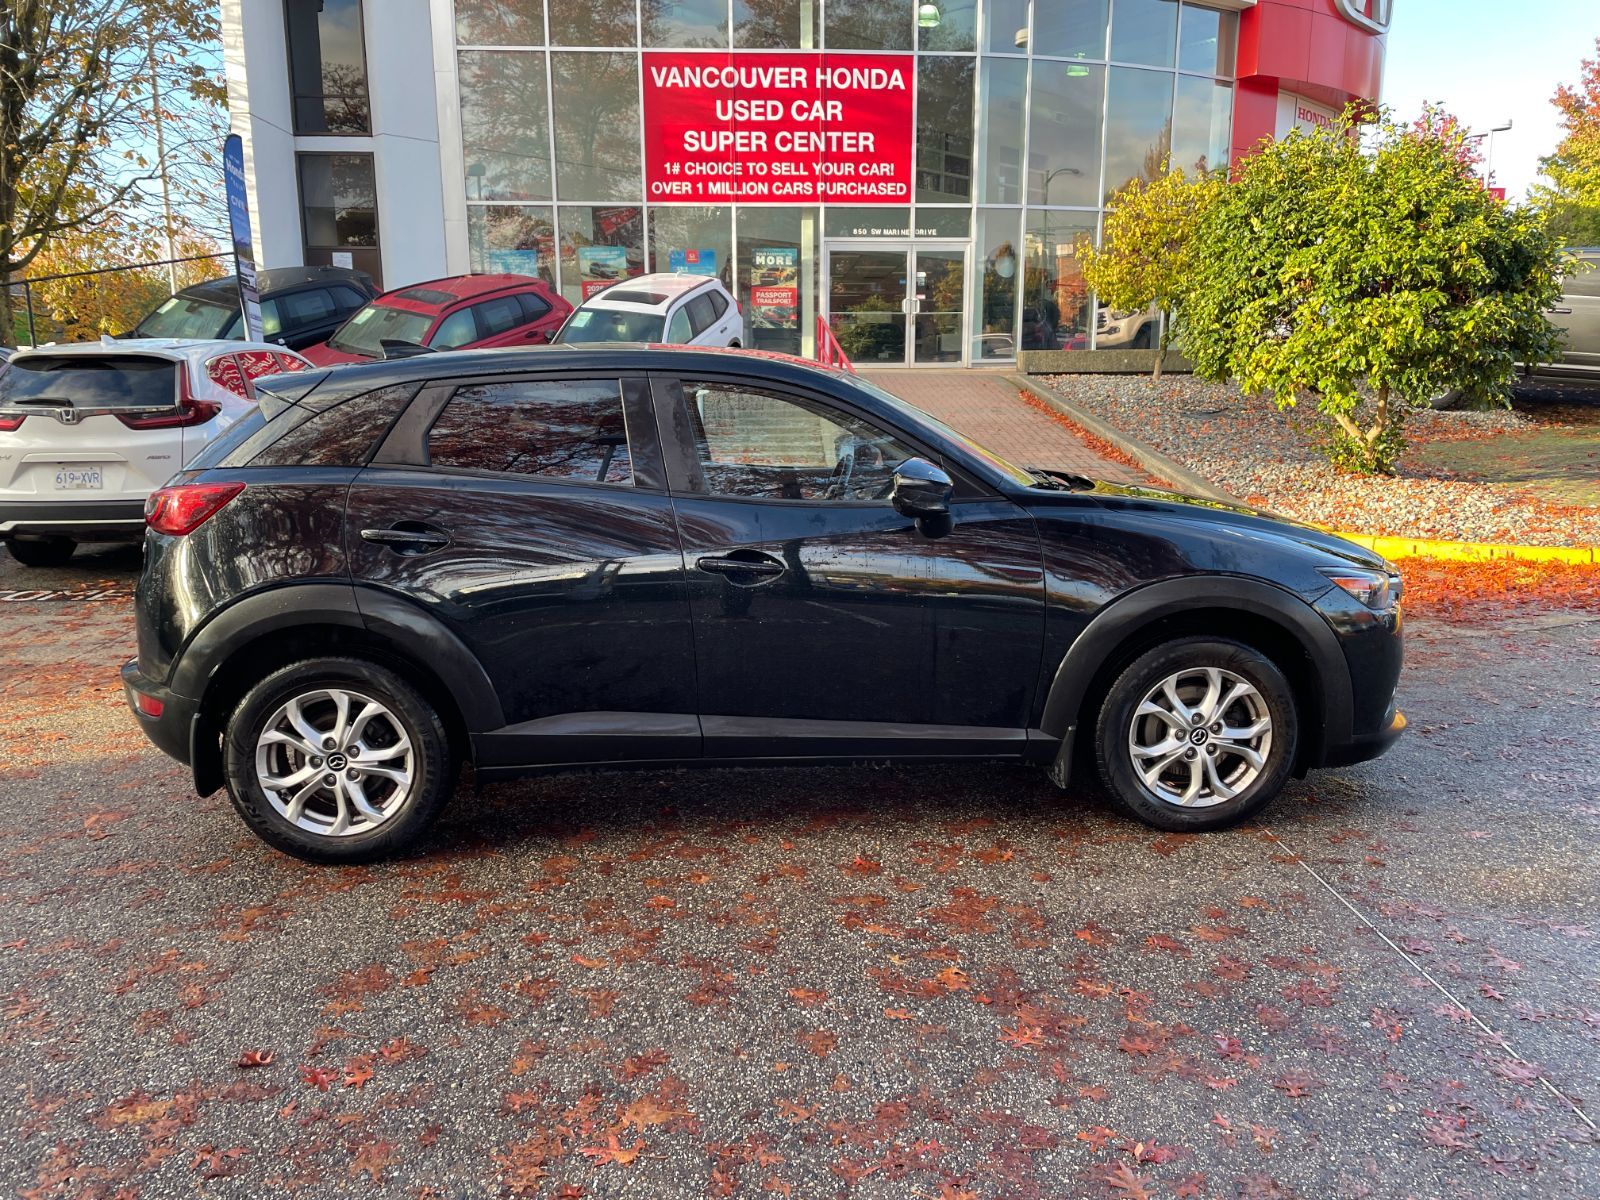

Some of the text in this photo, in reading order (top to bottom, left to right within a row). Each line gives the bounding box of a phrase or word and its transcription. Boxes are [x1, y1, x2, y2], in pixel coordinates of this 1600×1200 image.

[650, 66, 906, 90] VANCOUVER HONDA
[715, 99, 843, 122] USED CAR
[1298, 106, 1333, 129] HONDA
[683, 130, 875, 153] SUPER CENTER
[663, 161, 895, 176] 1# CHOICE TO SELL YOUR CAR!
[651, 181, 907, 196] OVER 1 MILLION CARS PURCHASED
[882, 228, 911, 236] MARINE
[915, 228, 937, 236] DRIVE
[755, 255, 793, 265] MORE
[56, 472, 100, 484] 619 XVR
